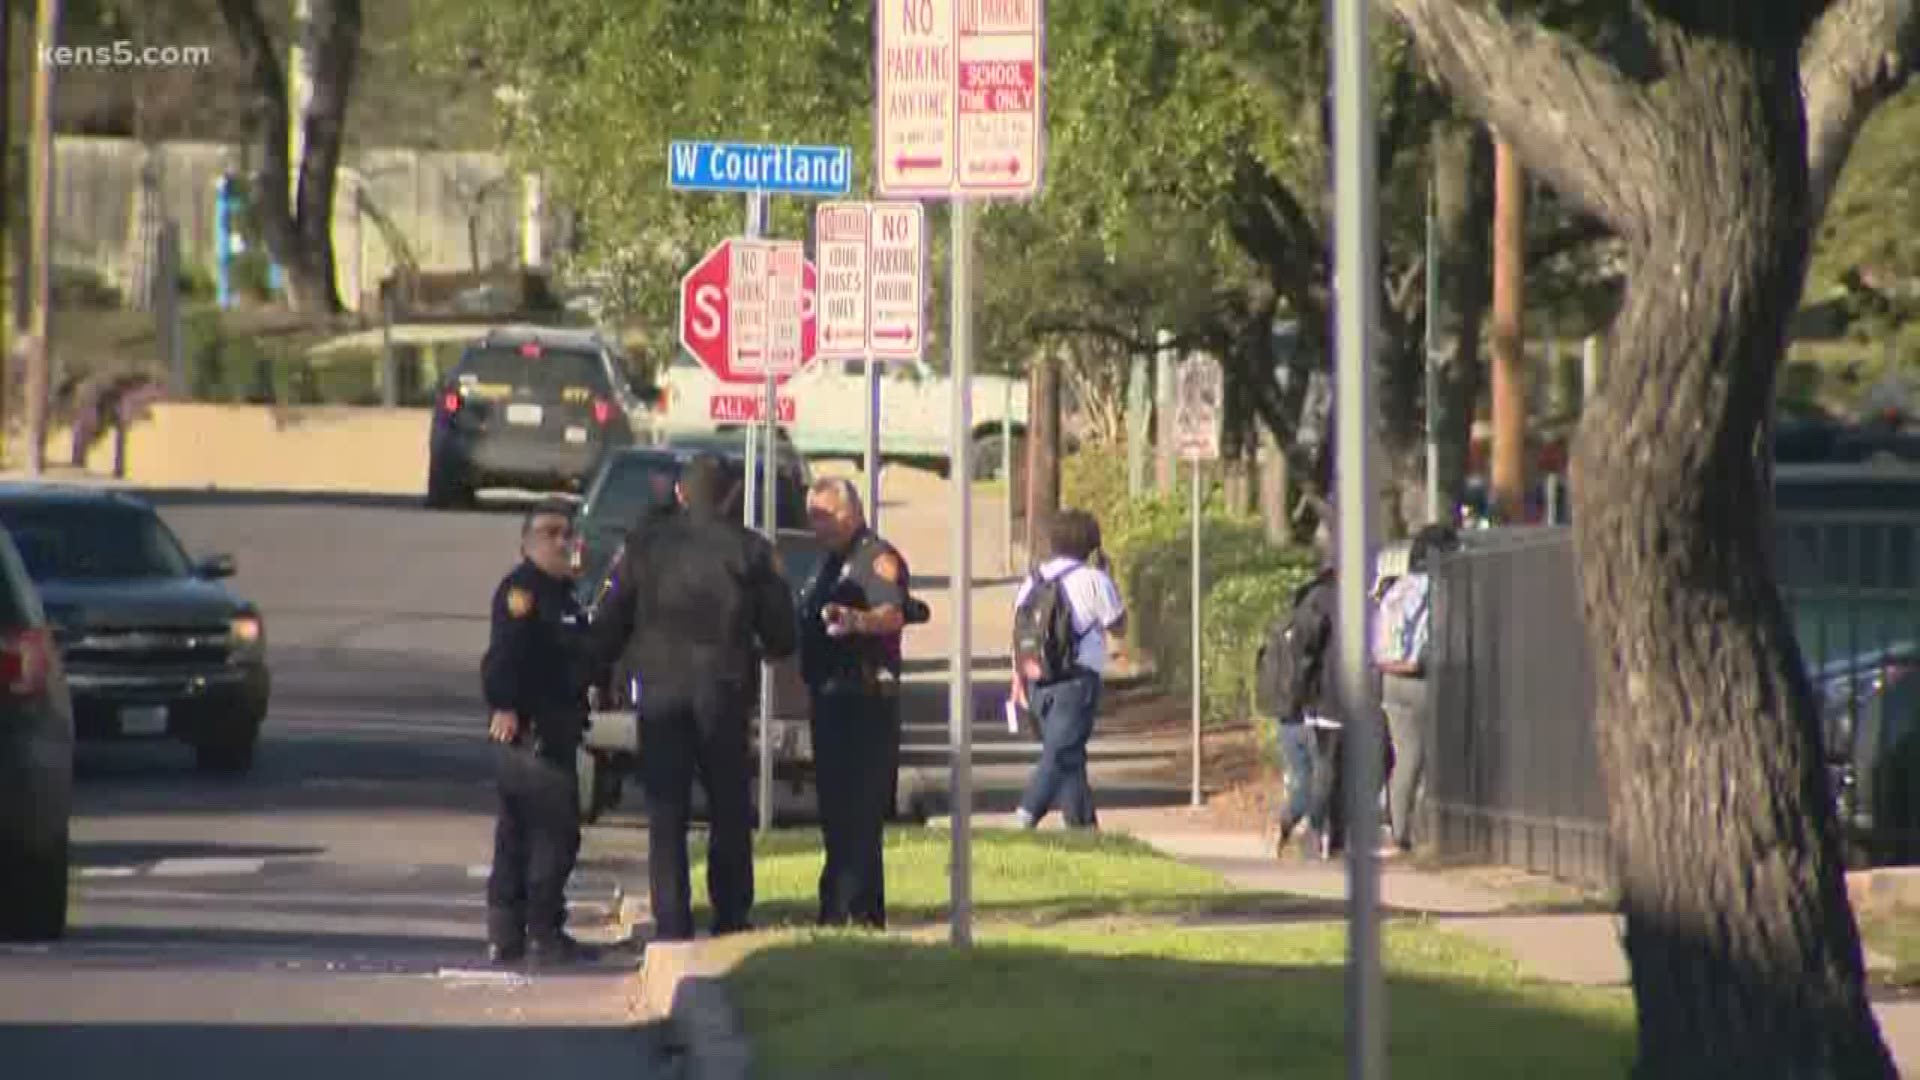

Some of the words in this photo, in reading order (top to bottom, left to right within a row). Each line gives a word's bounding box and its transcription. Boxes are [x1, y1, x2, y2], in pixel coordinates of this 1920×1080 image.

[903, 0, 933, 35] NO
[887, 45, 948, 80] PARKING
[967, 61, 1021, 87] SCHOOL
[889, 88, 946, 119] ANYTIME
[995, 88, 1034, 111] ONLY
[674, 143, 698, 181] W
[709, 144, 846, 187] Courtland
[881, 215, 909, 242] NO
[872, 247, 916, 276] PARKING
[691, 285, 816, 339] SP
[828, 296, 857, 319] ONLY
[715, 396, 747, 417] ALL
[754, 396, 794, 419] WY
